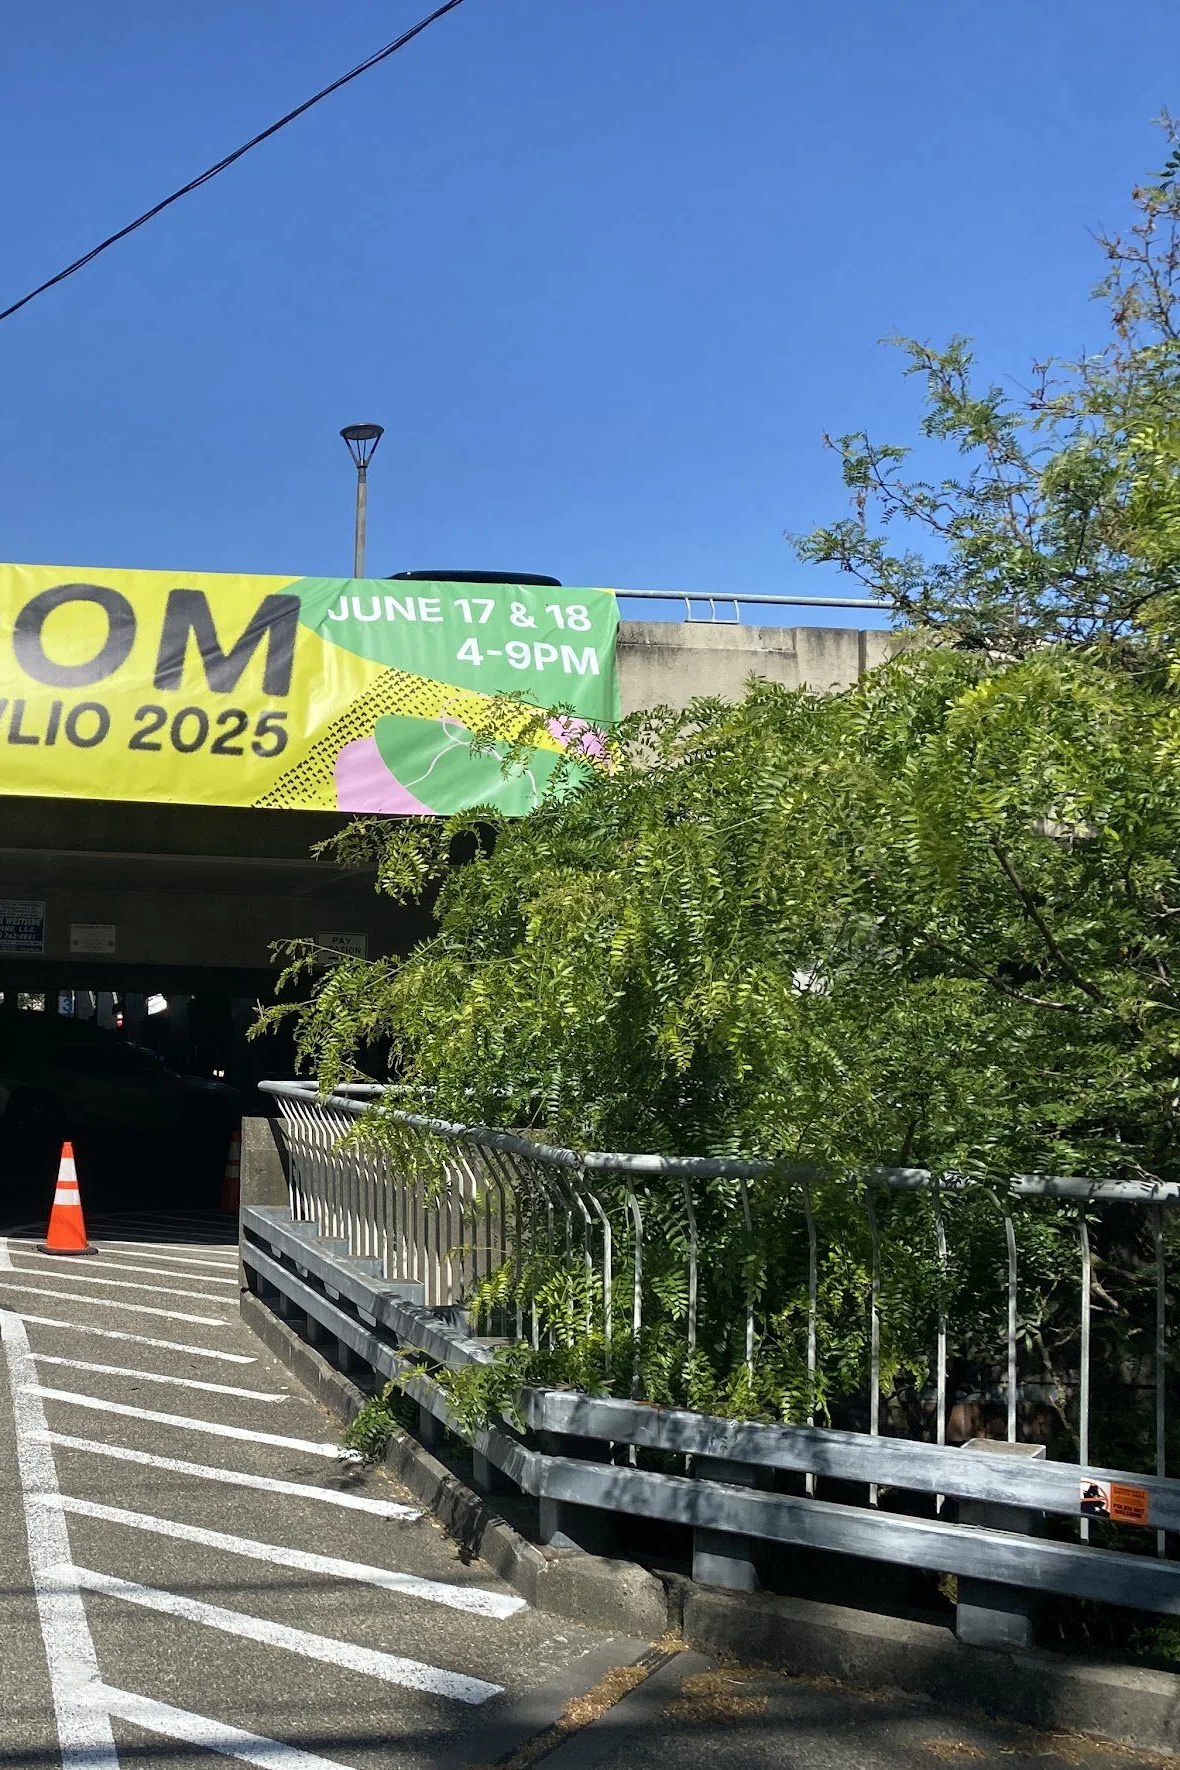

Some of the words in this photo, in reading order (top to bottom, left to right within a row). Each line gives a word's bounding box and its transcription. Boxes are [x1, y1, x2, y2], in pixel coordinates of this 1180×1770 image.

[328, 595, 444, 623] JUNE
[454, 598, 495, 624] 17
[510, 601, 538, 629] &
[545, 604, 592, 632] 18
[456, 637, 600, 676] 4-9PM
[128, 704, 289, 758] 2025
[332, 936, 352, 945] PAY
[62, 998, 73, 1012] 3
